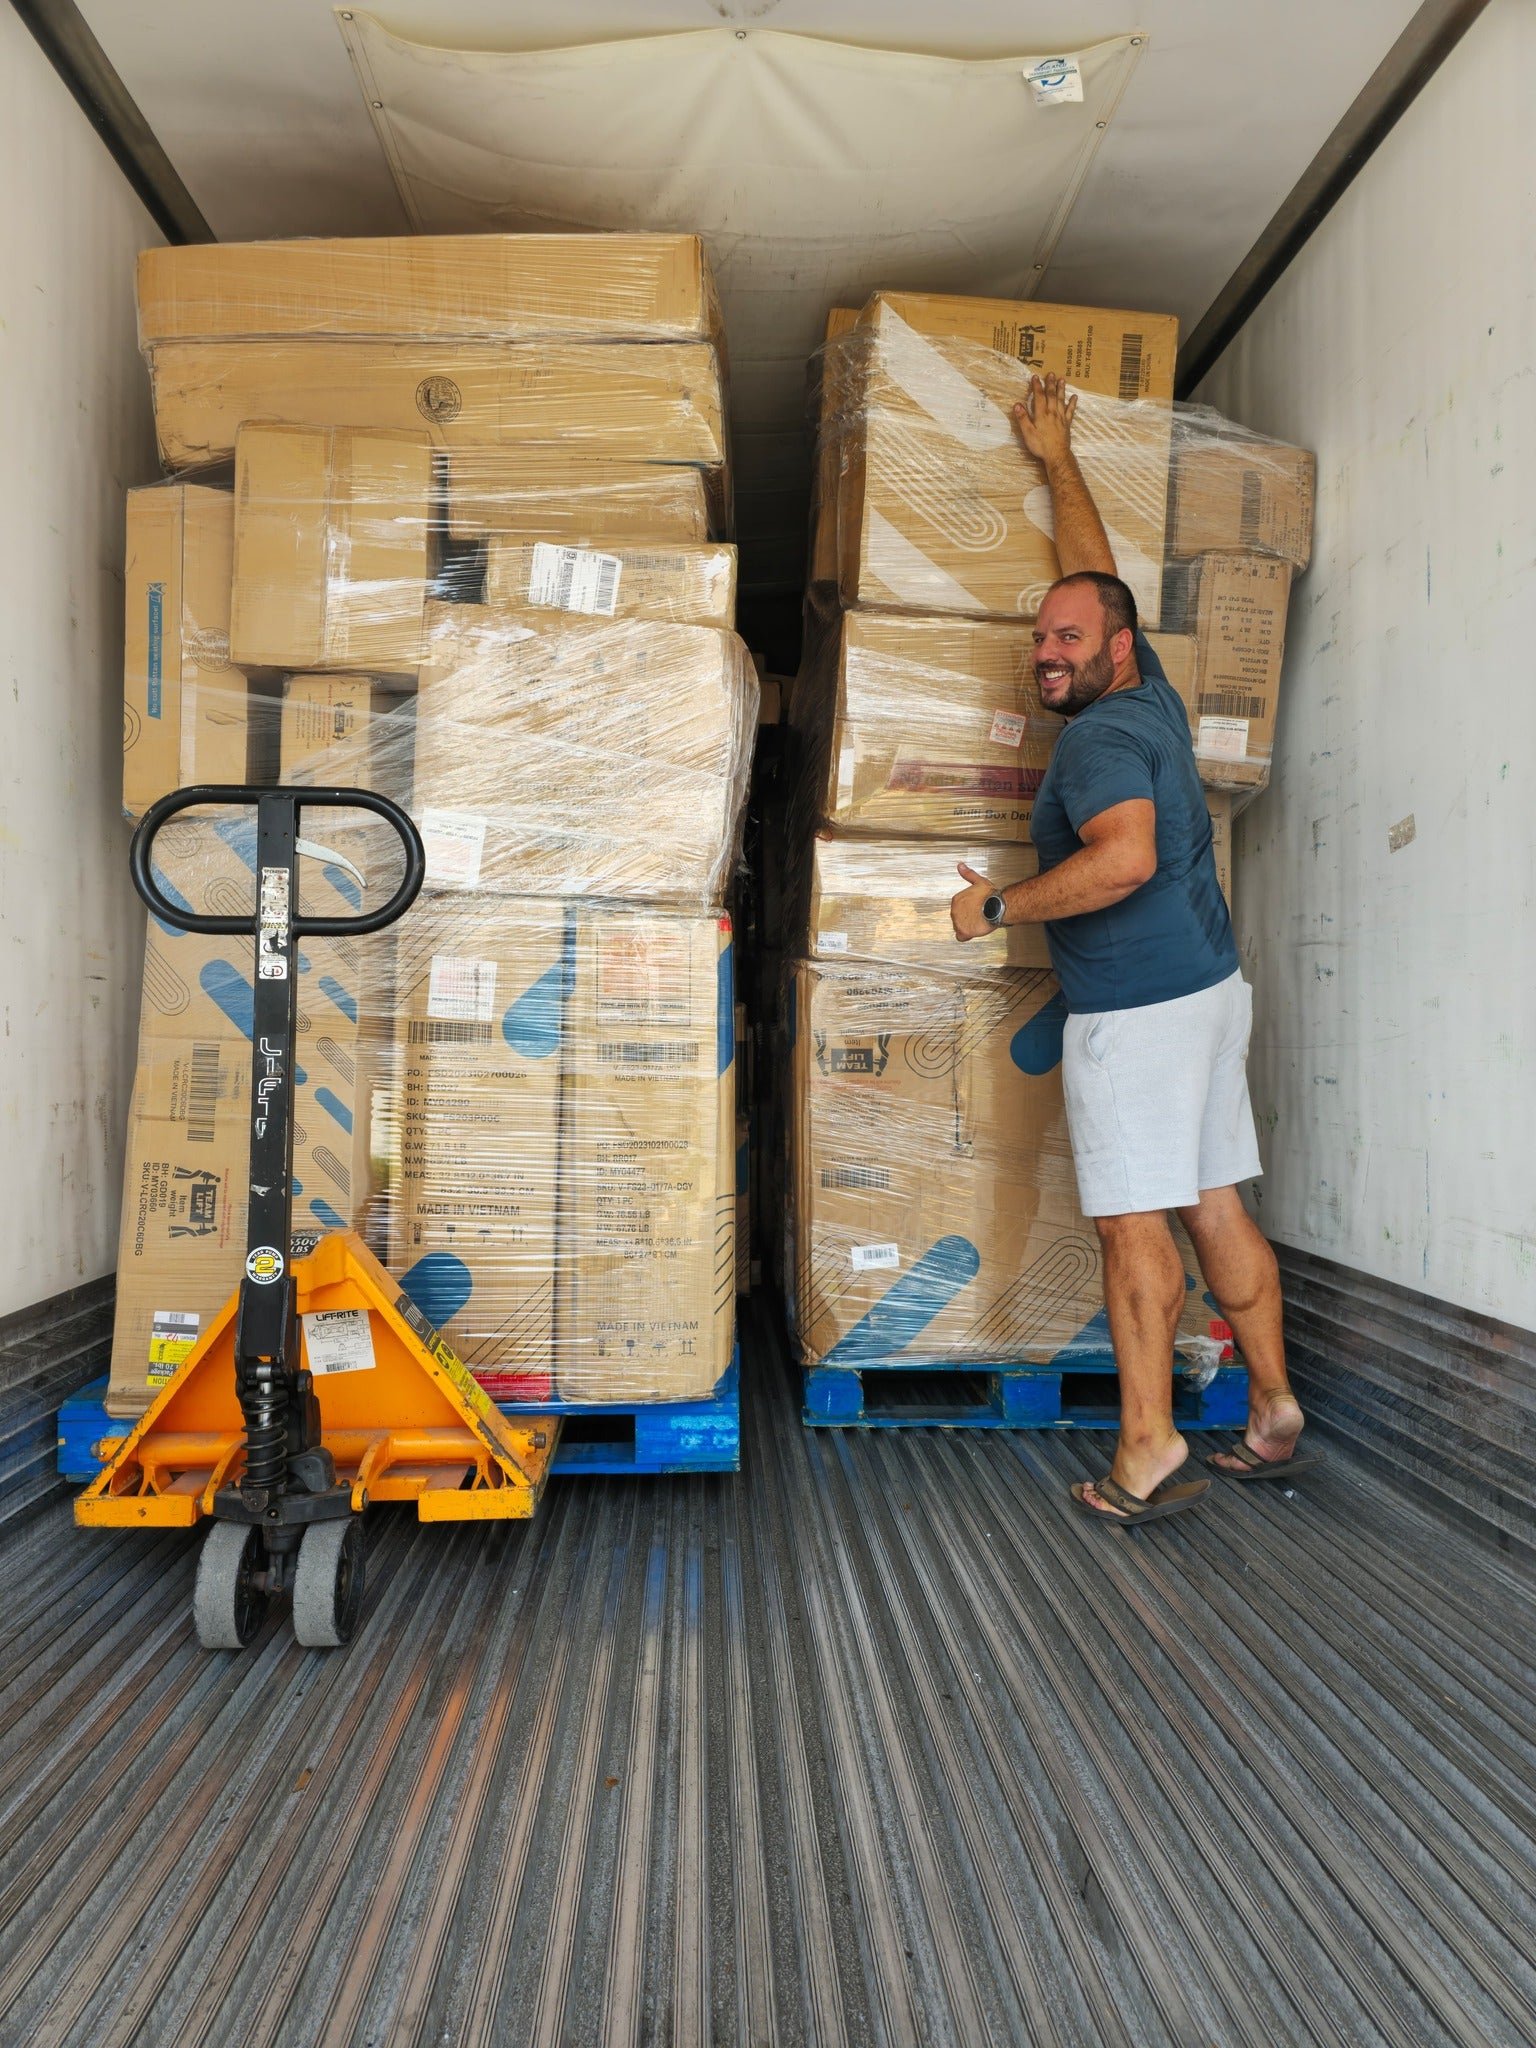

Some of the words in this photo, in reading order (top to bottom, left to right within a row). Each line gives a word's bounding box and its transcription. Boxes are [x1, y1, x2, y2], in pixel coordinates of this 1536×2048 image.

[152, 635, 160, 661] seating
[985, 809, 1007, 820] Box
[840, 1053, 865, 1061] LIFT
[172, 1060, 180, 1080] MADE
[836, 1061, 868, 1070] TEAM
[407, 1069, 423, 1077] PO:
[169, 1090, 177, 1122] VIETNAM
[406, 1098, 419, 1106] ID:
[406, 1112, 429, 1121] SKU:
[406, 1127, 428, 1136] QTY:
[405, 1142, 426, 1150] G.W:
[404, 1156, 427, 1164] N.W:
[141, 1161, 151, 1183] SKU:
[152, 1162, 160, 1174] ID:
[161, 1162, 169, 1178] BH:
[158, 1180, 168, 1208] GD019
[168, 1189, 177, 1218] weight
[178, 1195, 187, 1213] Item
[195, 1192, 204, 1215] LIFT
[204, 1189, 214, 1219] TEAM
[416, 1203, 450, 1215] MADE
[453, 1204, 465, 1215] IN
[468, 1204, 520, 1216] VIETNAM
[290, 1245, 310, 1253] LBS
[255, 1256, 275, 1274] 2
[596, 1321, 628, 1331] MADE
[633, 1322, 645, 1331] IN
[649, 1321, 699, 1331] VIETNAM
